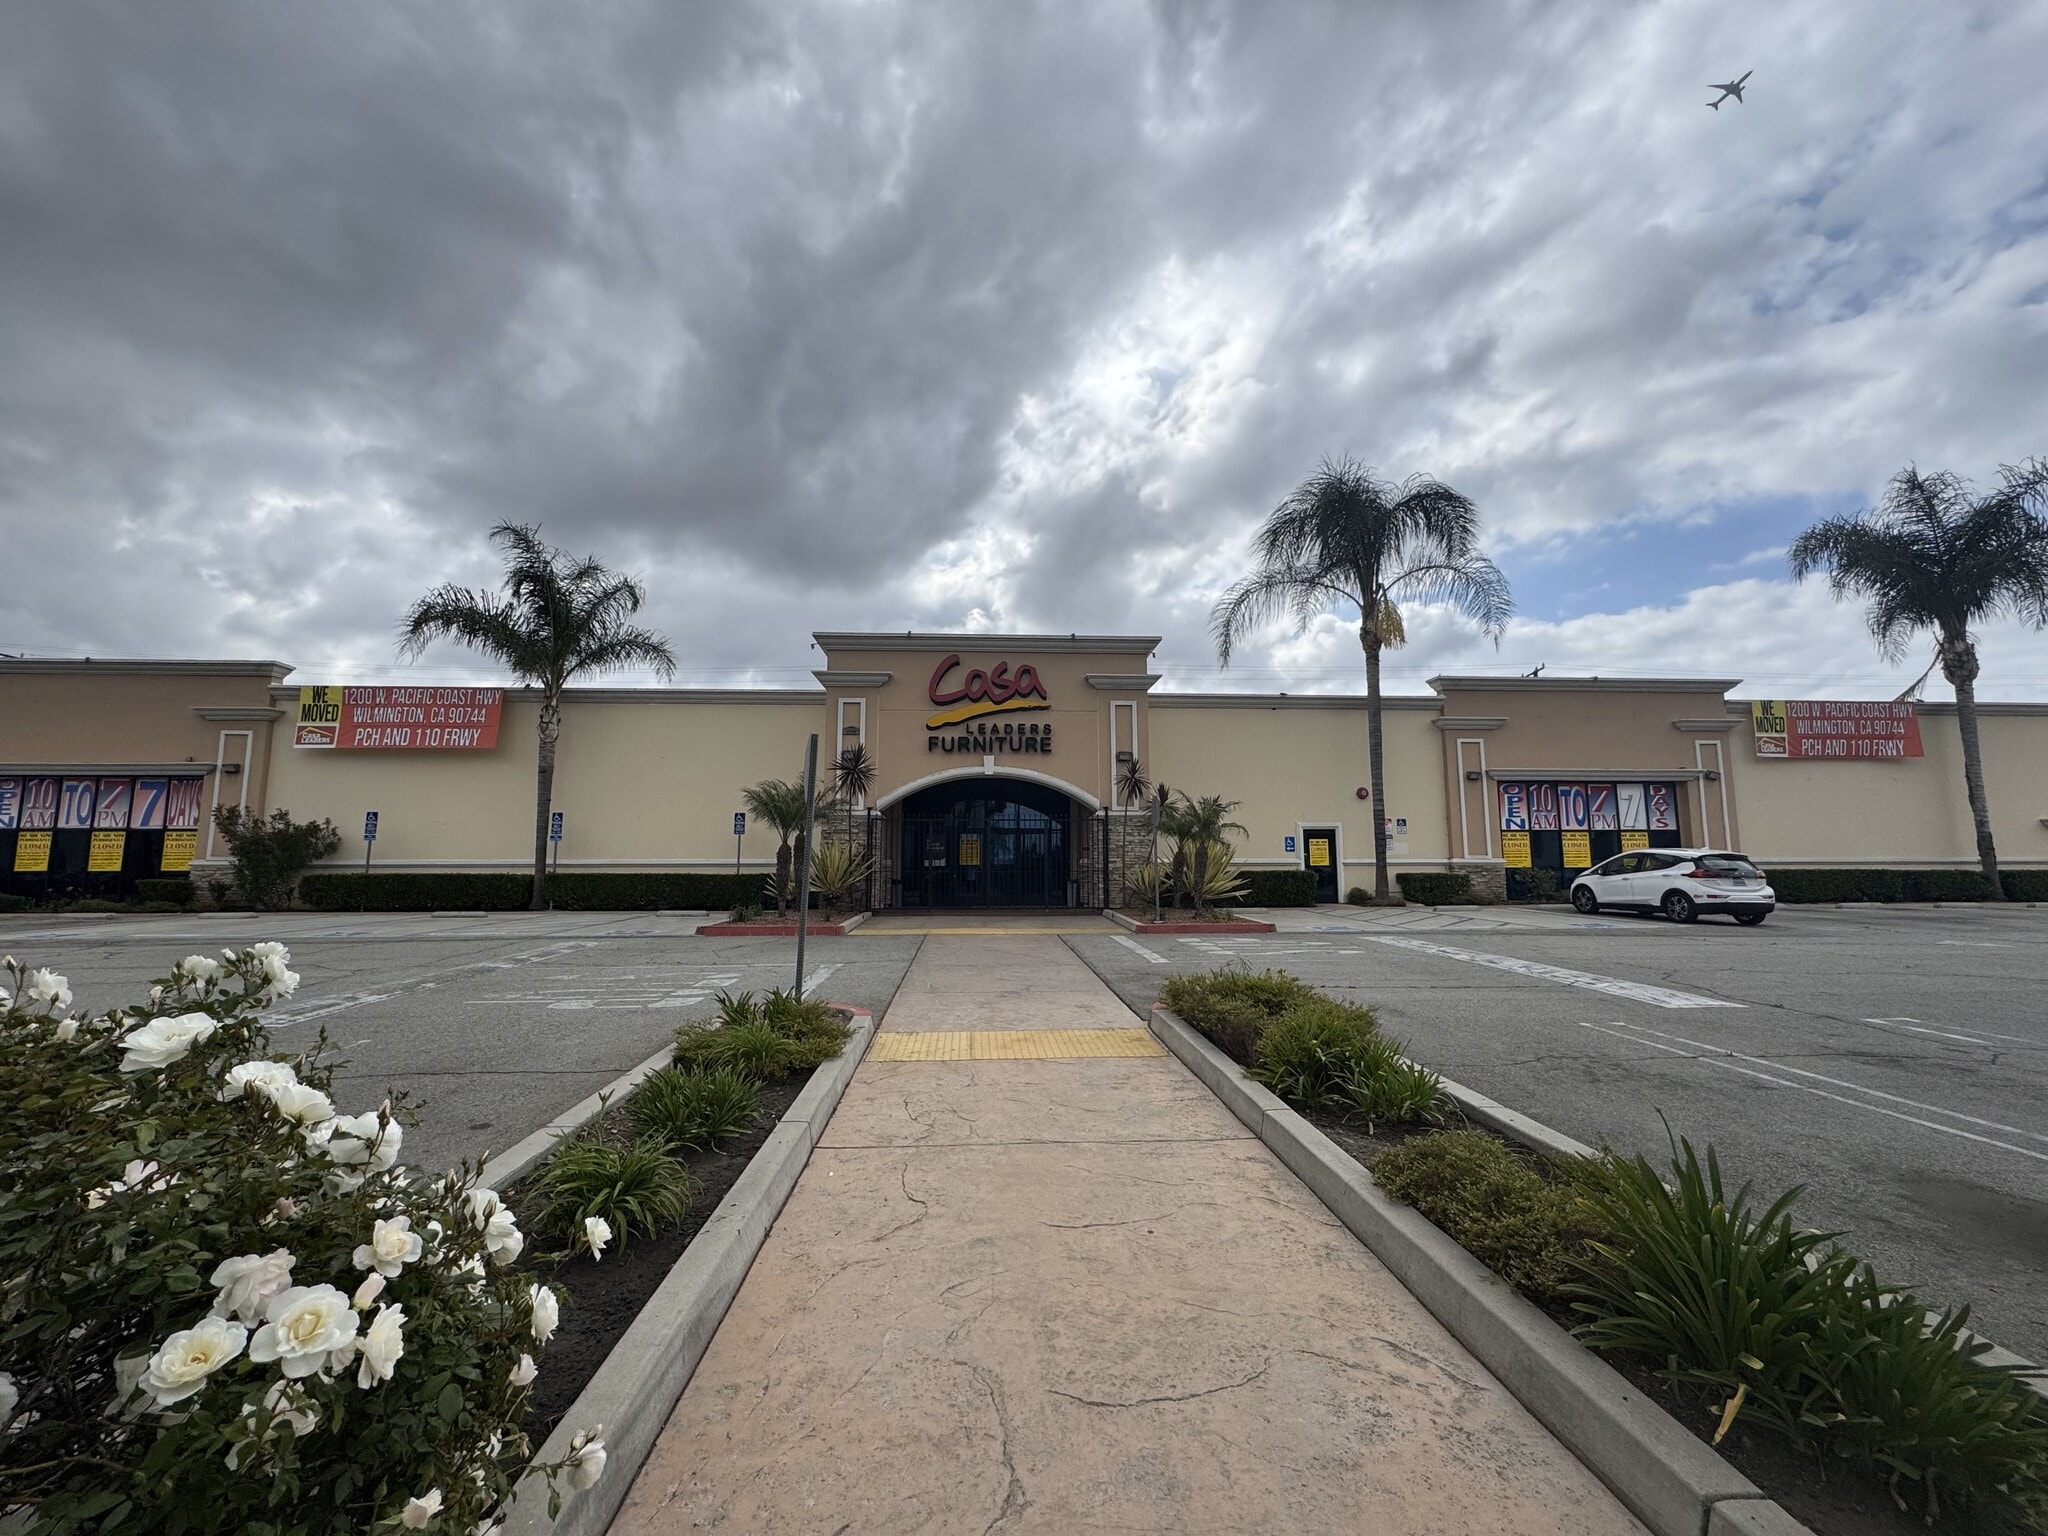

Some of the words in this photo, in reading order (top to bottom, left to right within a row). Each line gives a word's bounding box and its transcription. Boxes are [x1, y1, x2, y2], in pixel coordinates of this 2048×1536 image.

[928, 654, 1048, 706] Casa
[312, 686, 329, 703] WE
[344, 689, 372, 705] 1200
[376, 689, 389, 705] W.
[392, 689, 434, 705] PACIFIC
[436, 689, 473, 705] COAST
[476, 689, 502, 705] HWY
[300, 704, 339, 722] MOVED
[353, 707, 427, 724] WILMINGTON,
[430, 707, 445, 723] CA
[448, 708, 486, 723] 90744
[1760, 701, 1774, 716] WE
[1787, 703, 1809, 717] 1200
[1812, 703, 1823, 717] W.
[1825, 703, 1860, 717] PACIFIC
[1861, 703, 1891, 717] COAST
[1893, 703, 1913, 717] HWY
[966, 723, 1052, 735] LEADERS
[1756, 717, 1786, 733] MOVED
[1797, 720, 1858, 736] WILMINGTON,
[1860, 720, 1872, 734] CA
[1874, 720, 1905, 735] 90744
[354, 728, 379, 746] PCH
[383, 728, 410, 746] AND
[415, 729, 440, 746] 110
[443, 729, 482, 746] FRWY
[928, 736, 1052, 753] FURNITURE
[1802, 739, 1822, 756] PCH
[1824, 739, 1847, 756] AND
[1851, 740, 1870, 756] 110
[1872, 740, 1904, 756] FRWY
[27, 779, 54, 809] 10
[100, 778, 130, 809] 7
[1530, 784, 1553, 812] 10
[1588, 785, 1612, 812] 7
[64, 780, 94, 826] TO
[139, 779, 168, 828] 7
[166, 780, 203, 826] DAYS
[1500, 784, 1527, 829] OPEN
[1558, 785, 1587, 827] TO
[1620, 792, 1642, 828] 7
[1650, 785, 1671, 828] DAYS
[22, 810, 55, 828] AM
[97, 810, 128, 828] PM
[1531, 812, 1559, 829] AM
[1590, 813, 1618, 829] PM
